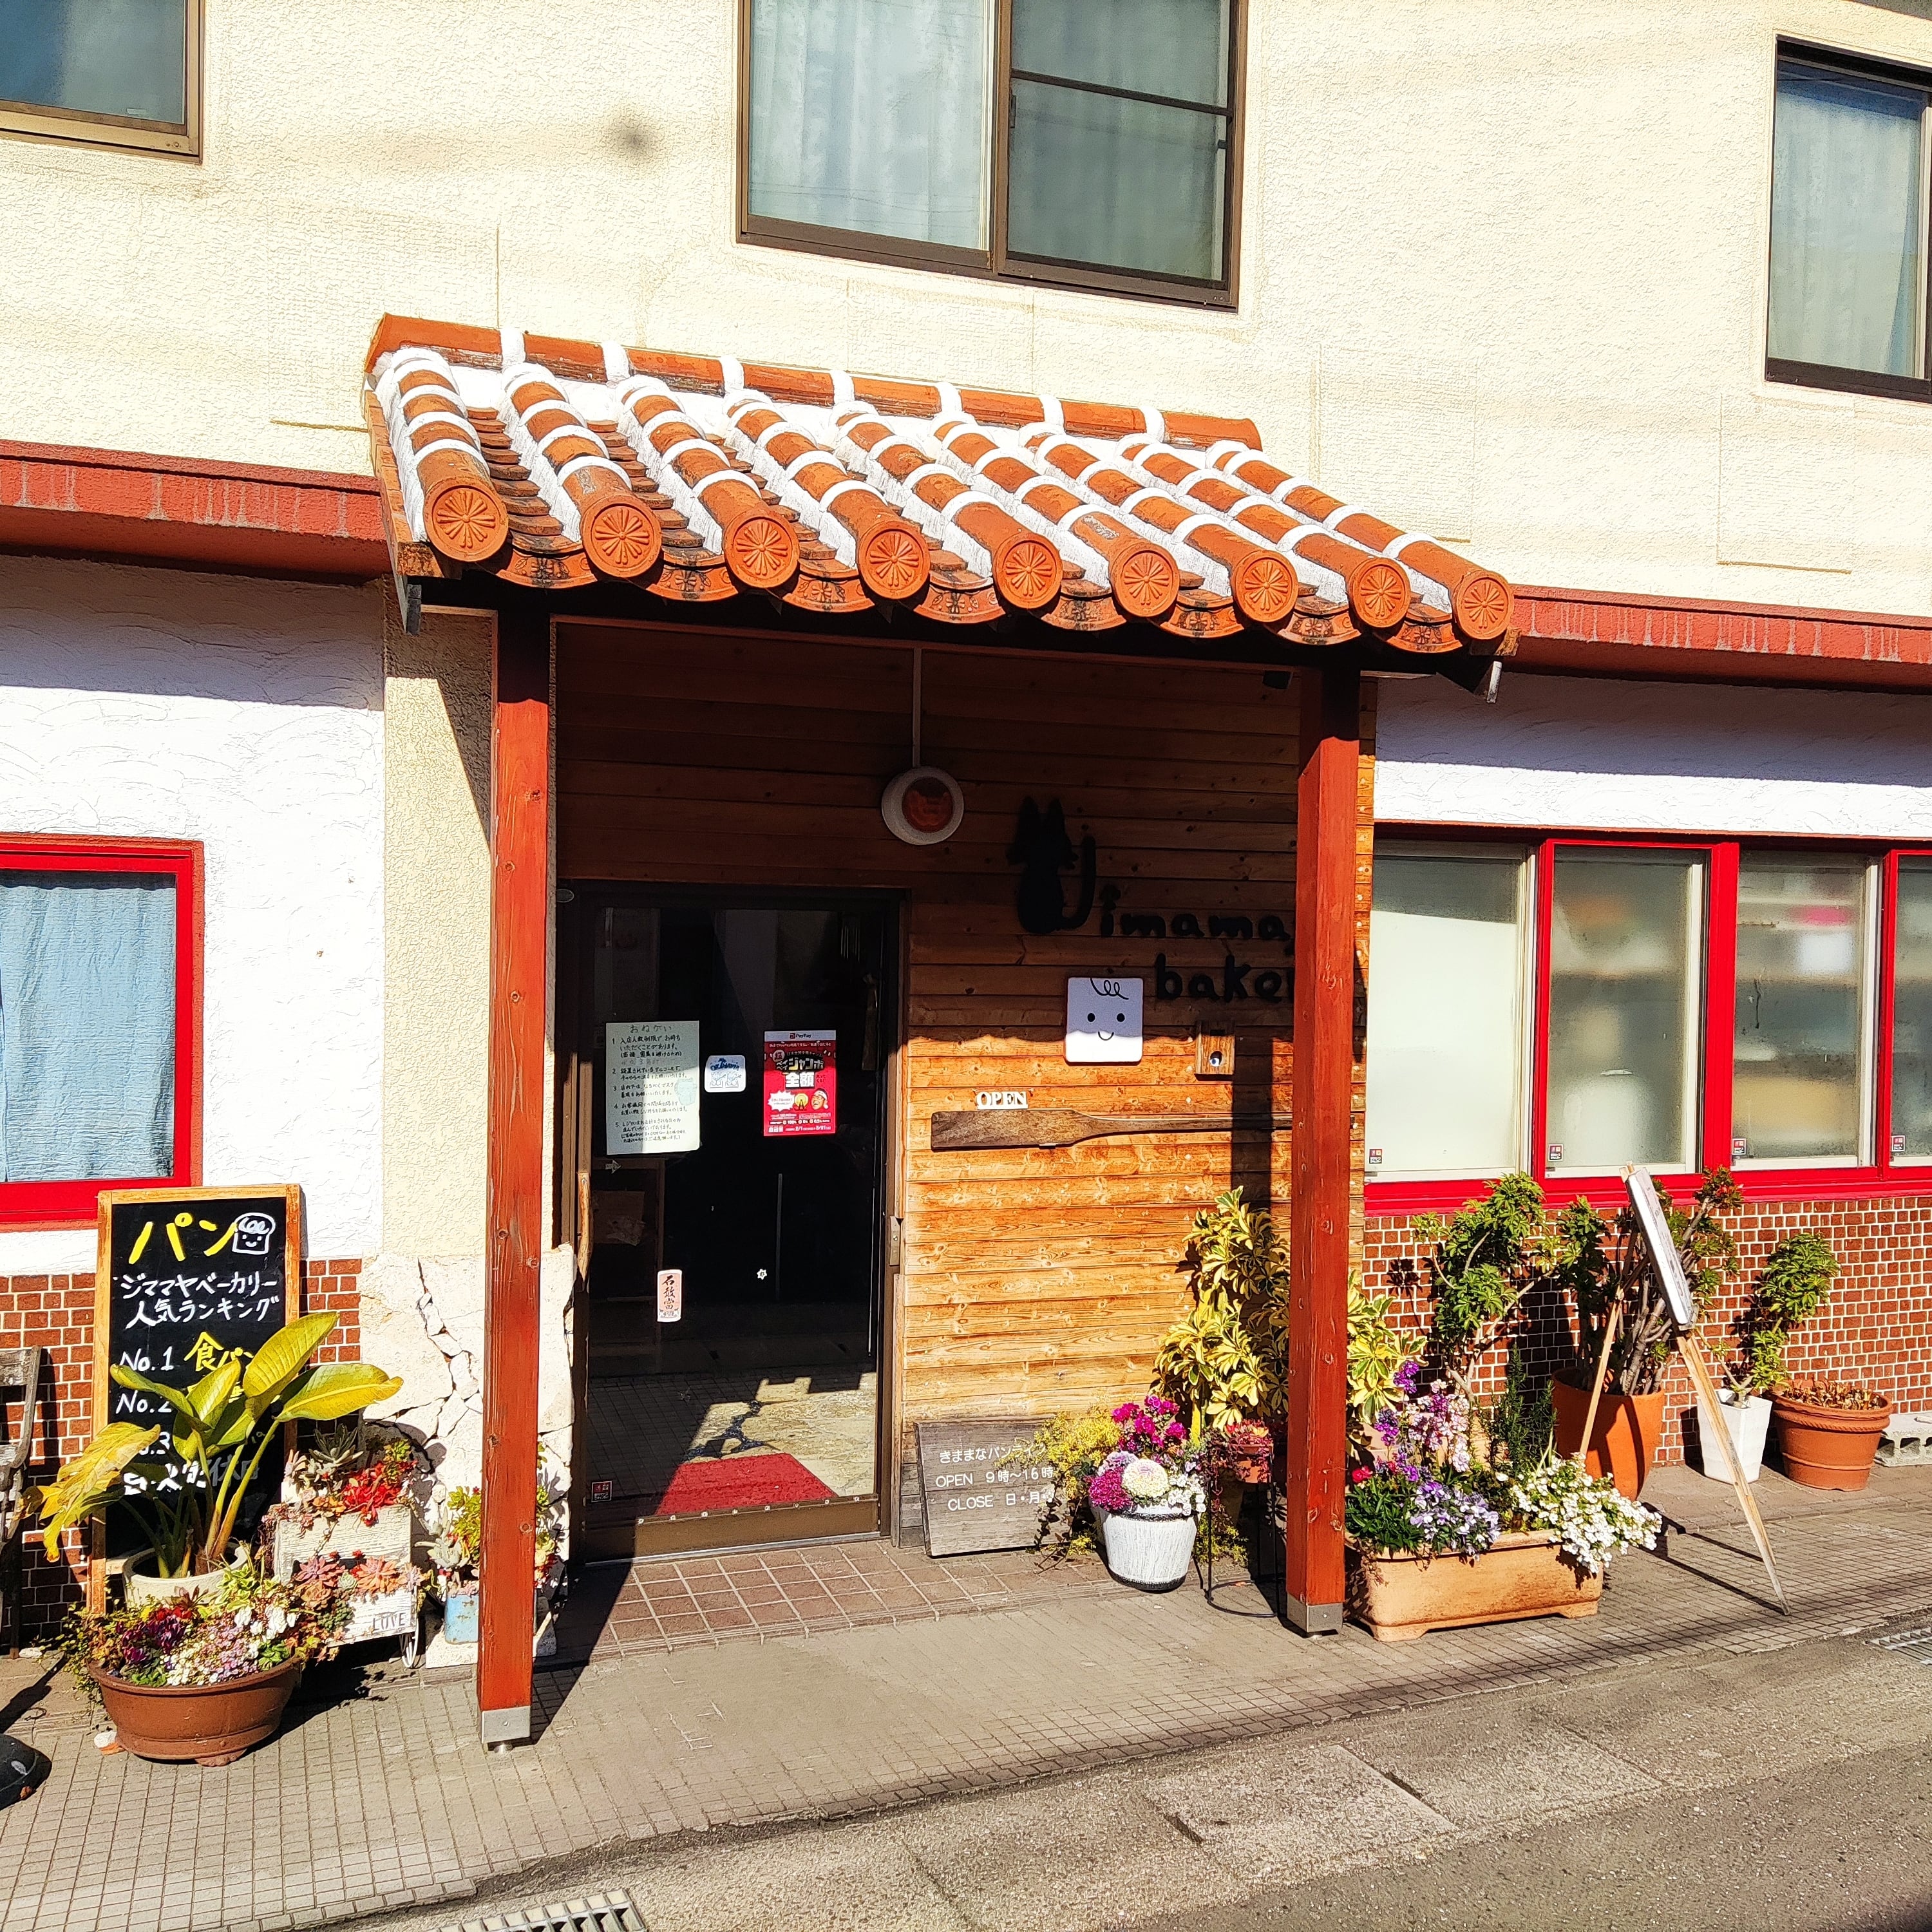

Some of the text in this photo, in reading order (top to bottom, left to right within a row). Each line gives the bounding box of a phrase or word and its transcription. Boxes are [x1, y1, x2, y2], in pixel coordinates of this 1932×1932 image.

[789, 1057, 824, 1070] ジャンボ
[785, 1072, 815, 1088] 全額
[976, 1092, 1028, 1110] OPEN
[129, 1212, 238, 1265] パン
[120, 1271, 278, 1299] ジママヤベーカリー
[125, 1295, 279, 1329] 人気ランキング
[936, 1473, 973, 1488] OPEN
[947, 1495, 994, 1511] CLOSE
